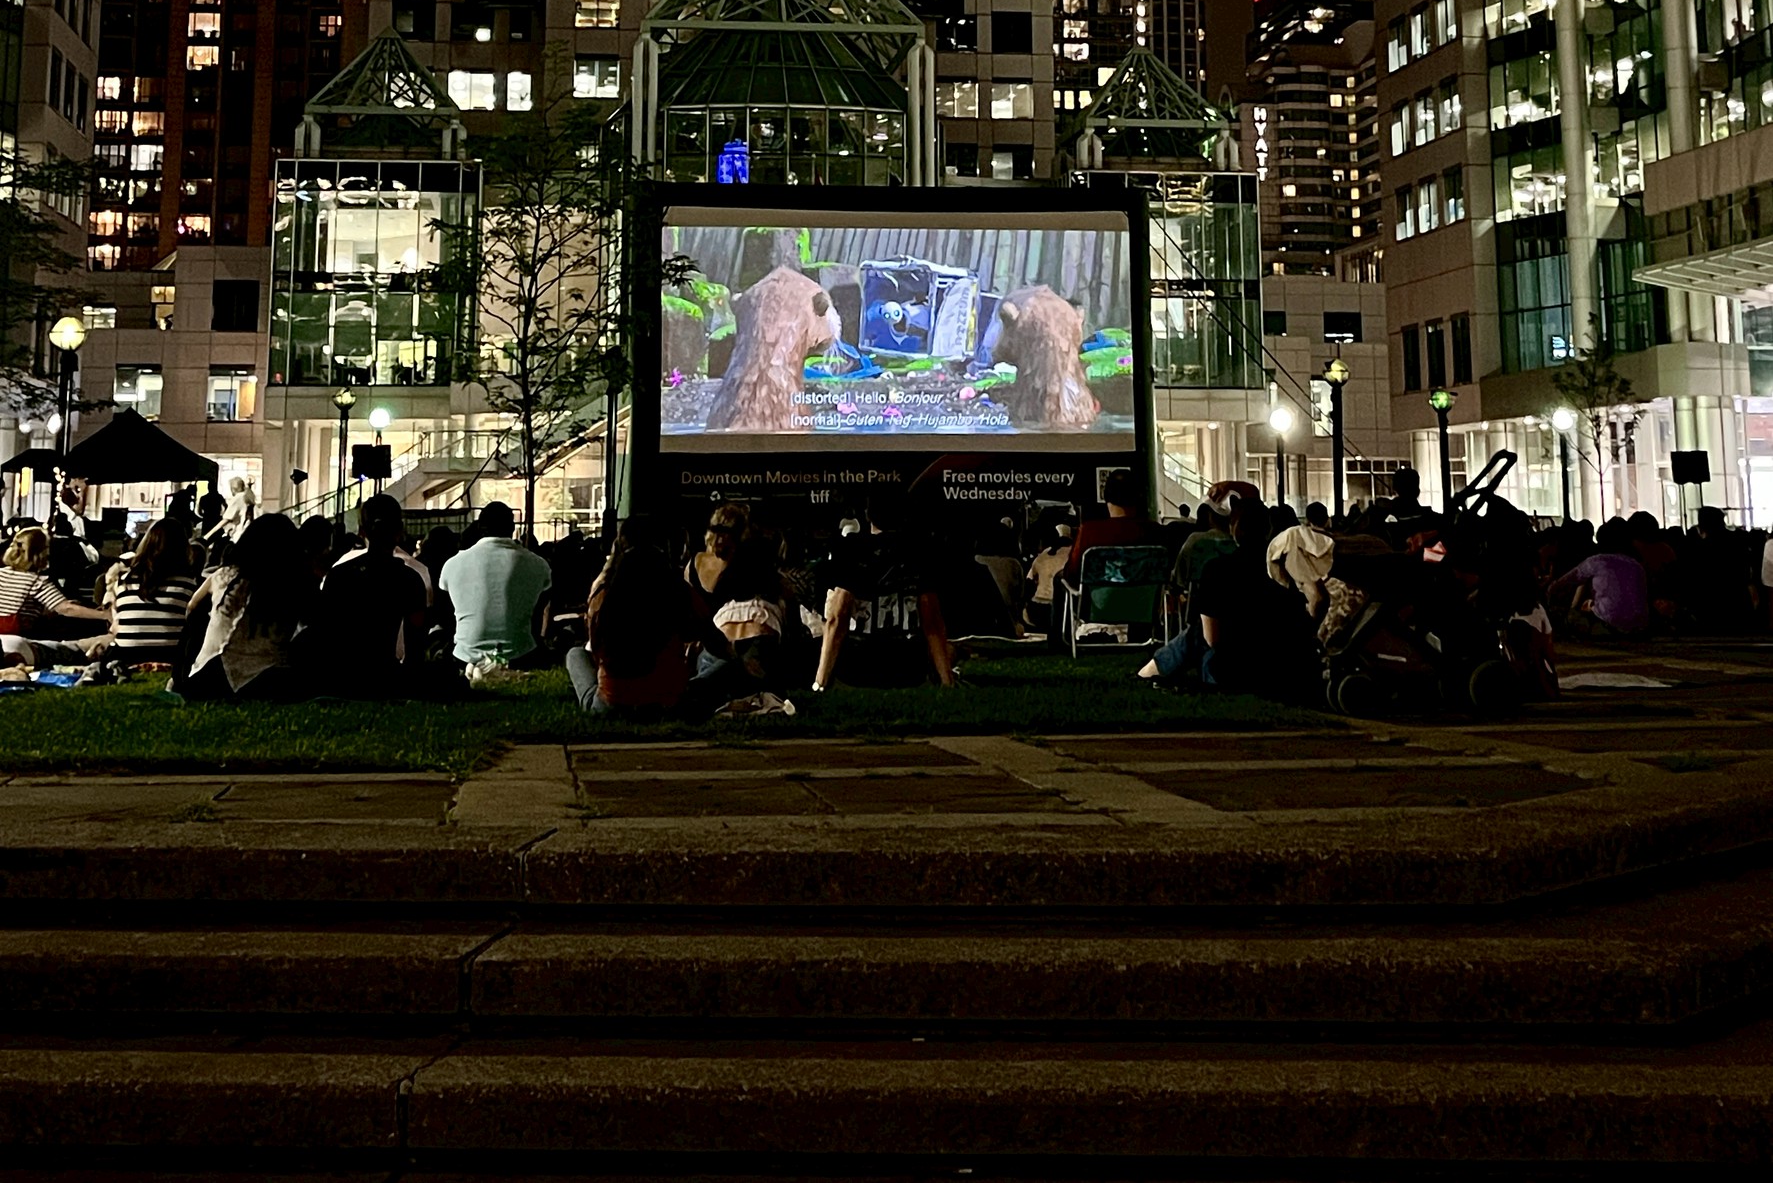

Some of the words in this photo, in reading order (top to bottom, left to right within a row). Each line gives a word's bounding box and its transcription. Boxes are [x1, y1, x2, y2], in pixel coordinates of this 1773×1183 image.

[1253, 106, 1268, 181] HYATT
[681, 470, 762, 485] Downtown
[766, 470, 820, 484] Movies
[823, 470, 836, 483] in
[840, 470, 865, 483] the
[867, 469, 902, 483] Park
[942, 469, 976, 483] Free
[978, 469, 1031, 484] movies
[1034, 472, 1075, 486] every
[810, 489, 830, 504] tiff
[943, 486, 1031, 500] Wednesday
